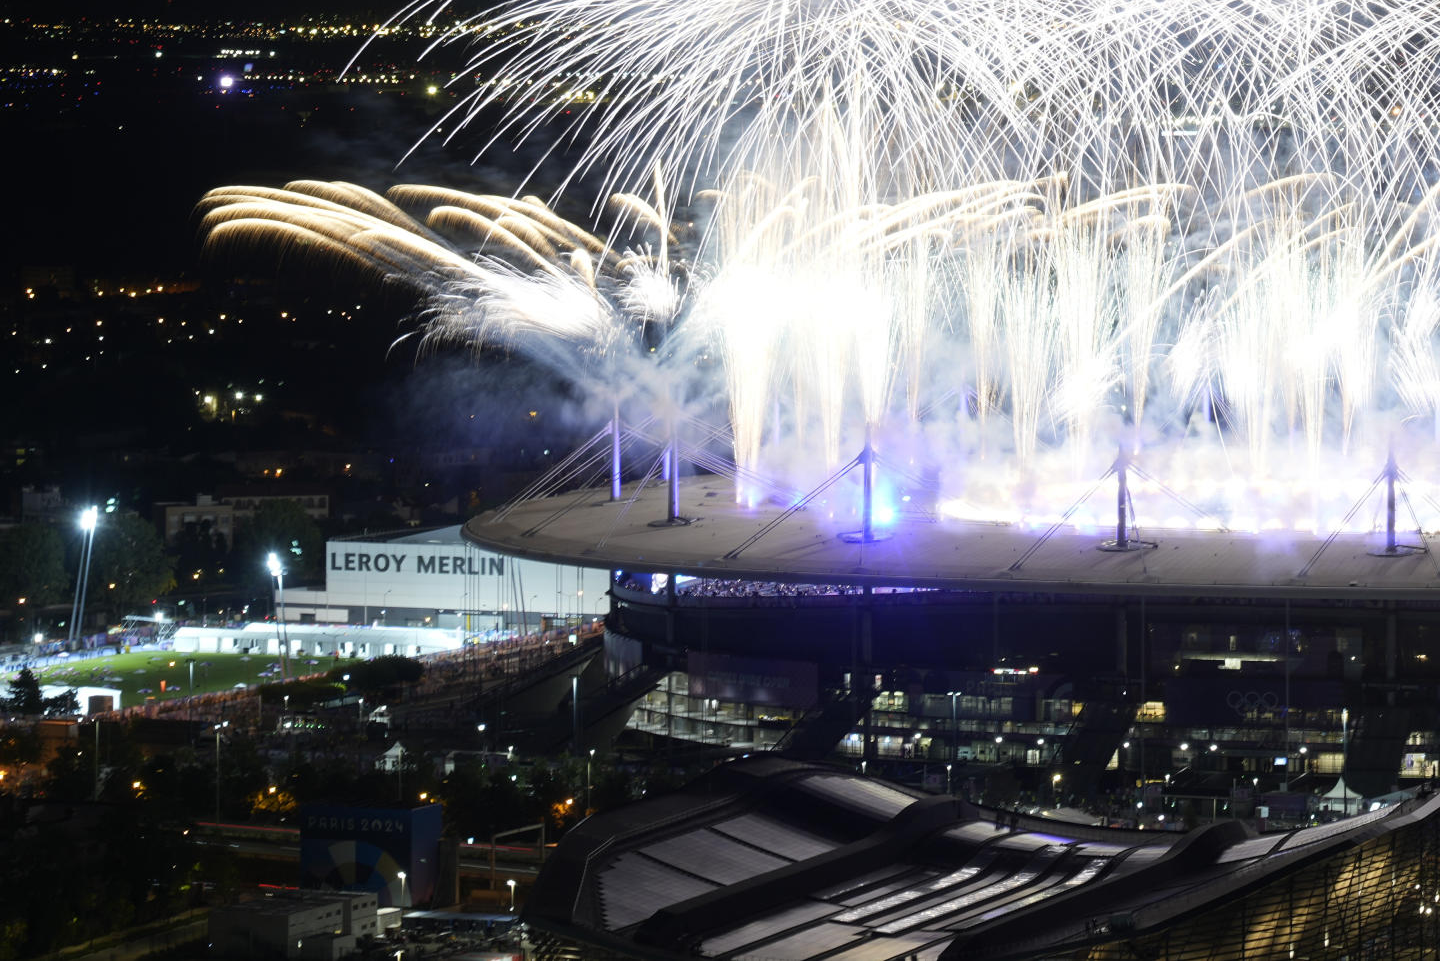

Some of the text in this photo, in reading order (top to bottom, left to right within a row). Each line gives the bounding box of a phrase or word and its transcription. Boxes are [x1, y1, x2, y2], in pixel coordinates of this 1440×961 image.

[331, 553, 503, 576] LEROY MERLIN
[307, 815, 404, 833] PARIS 2024
